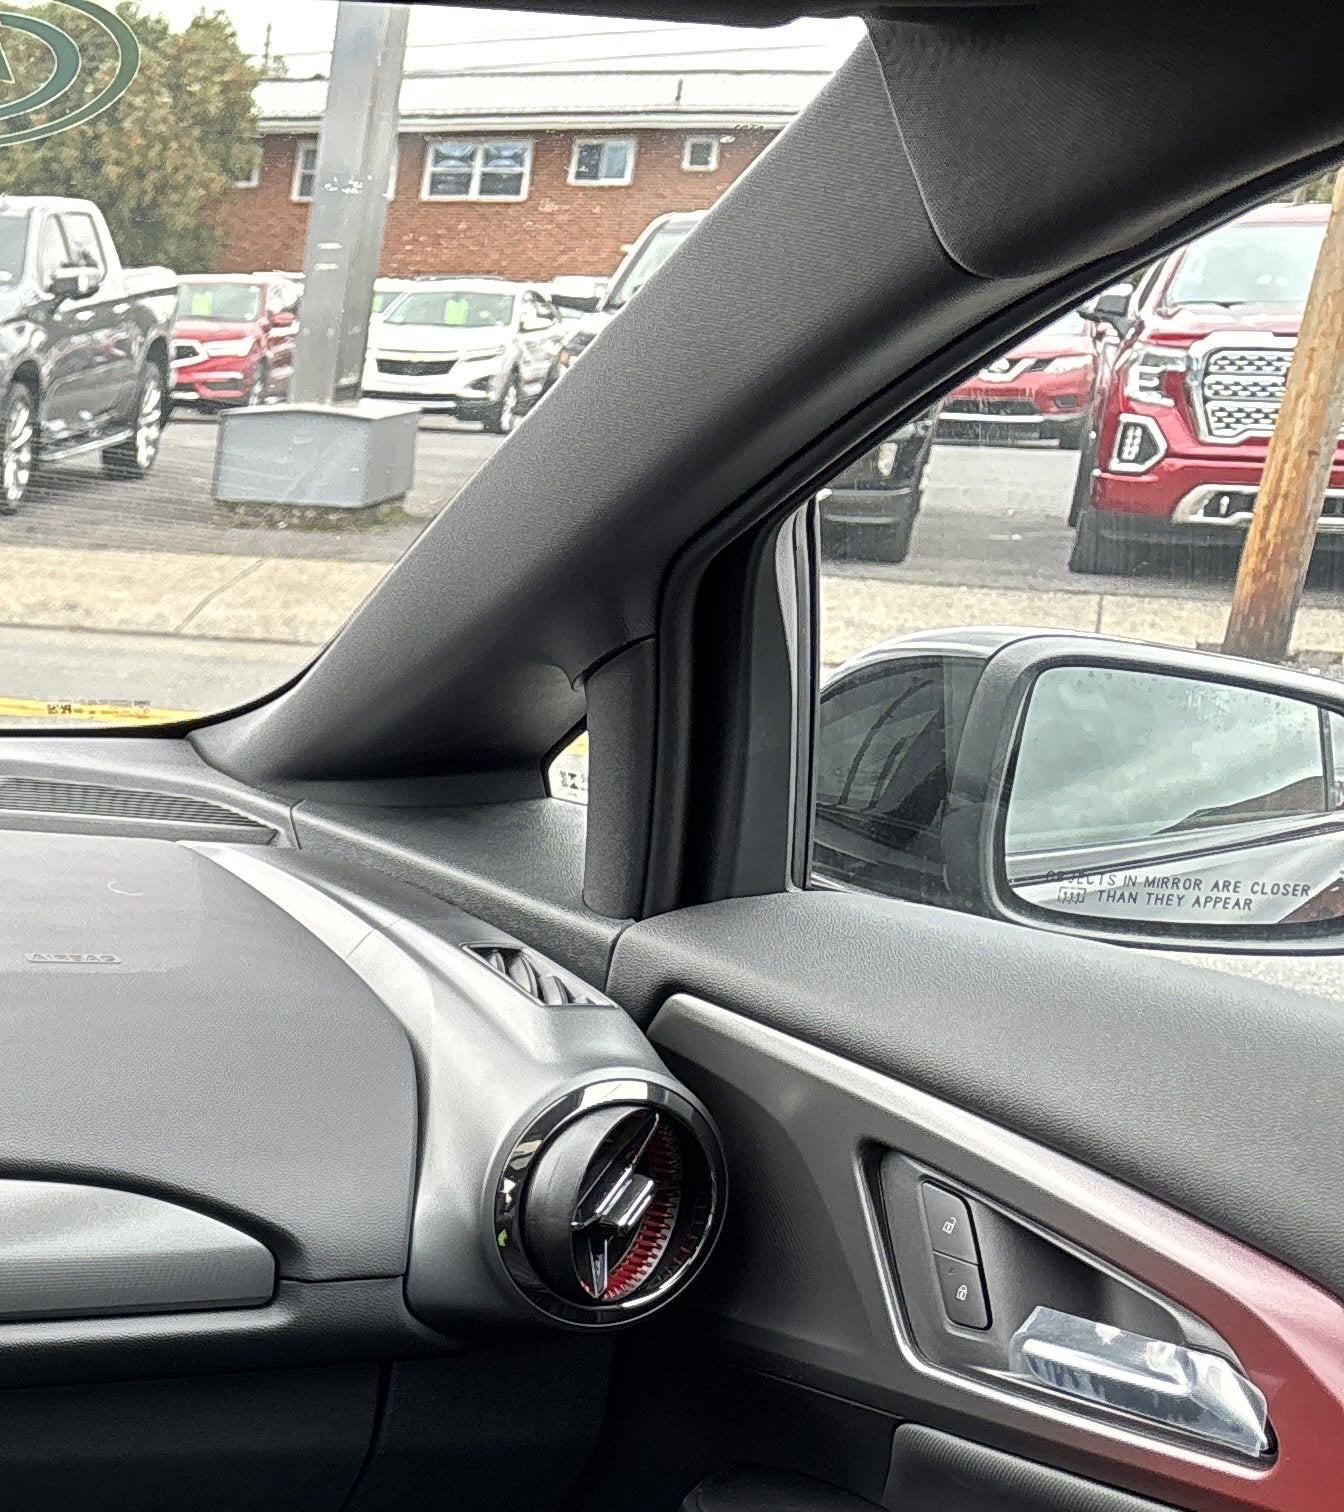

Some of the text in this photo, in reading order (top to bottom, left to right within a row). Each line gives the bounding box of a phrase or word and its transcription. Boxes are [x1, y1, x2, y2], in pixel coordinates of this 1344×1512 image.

[1046, 870, 1311, 897] OJECTS IN MIRROR ARE CLOSER
[1097, 890, 1253, 911] THAN THEY APPEAR
